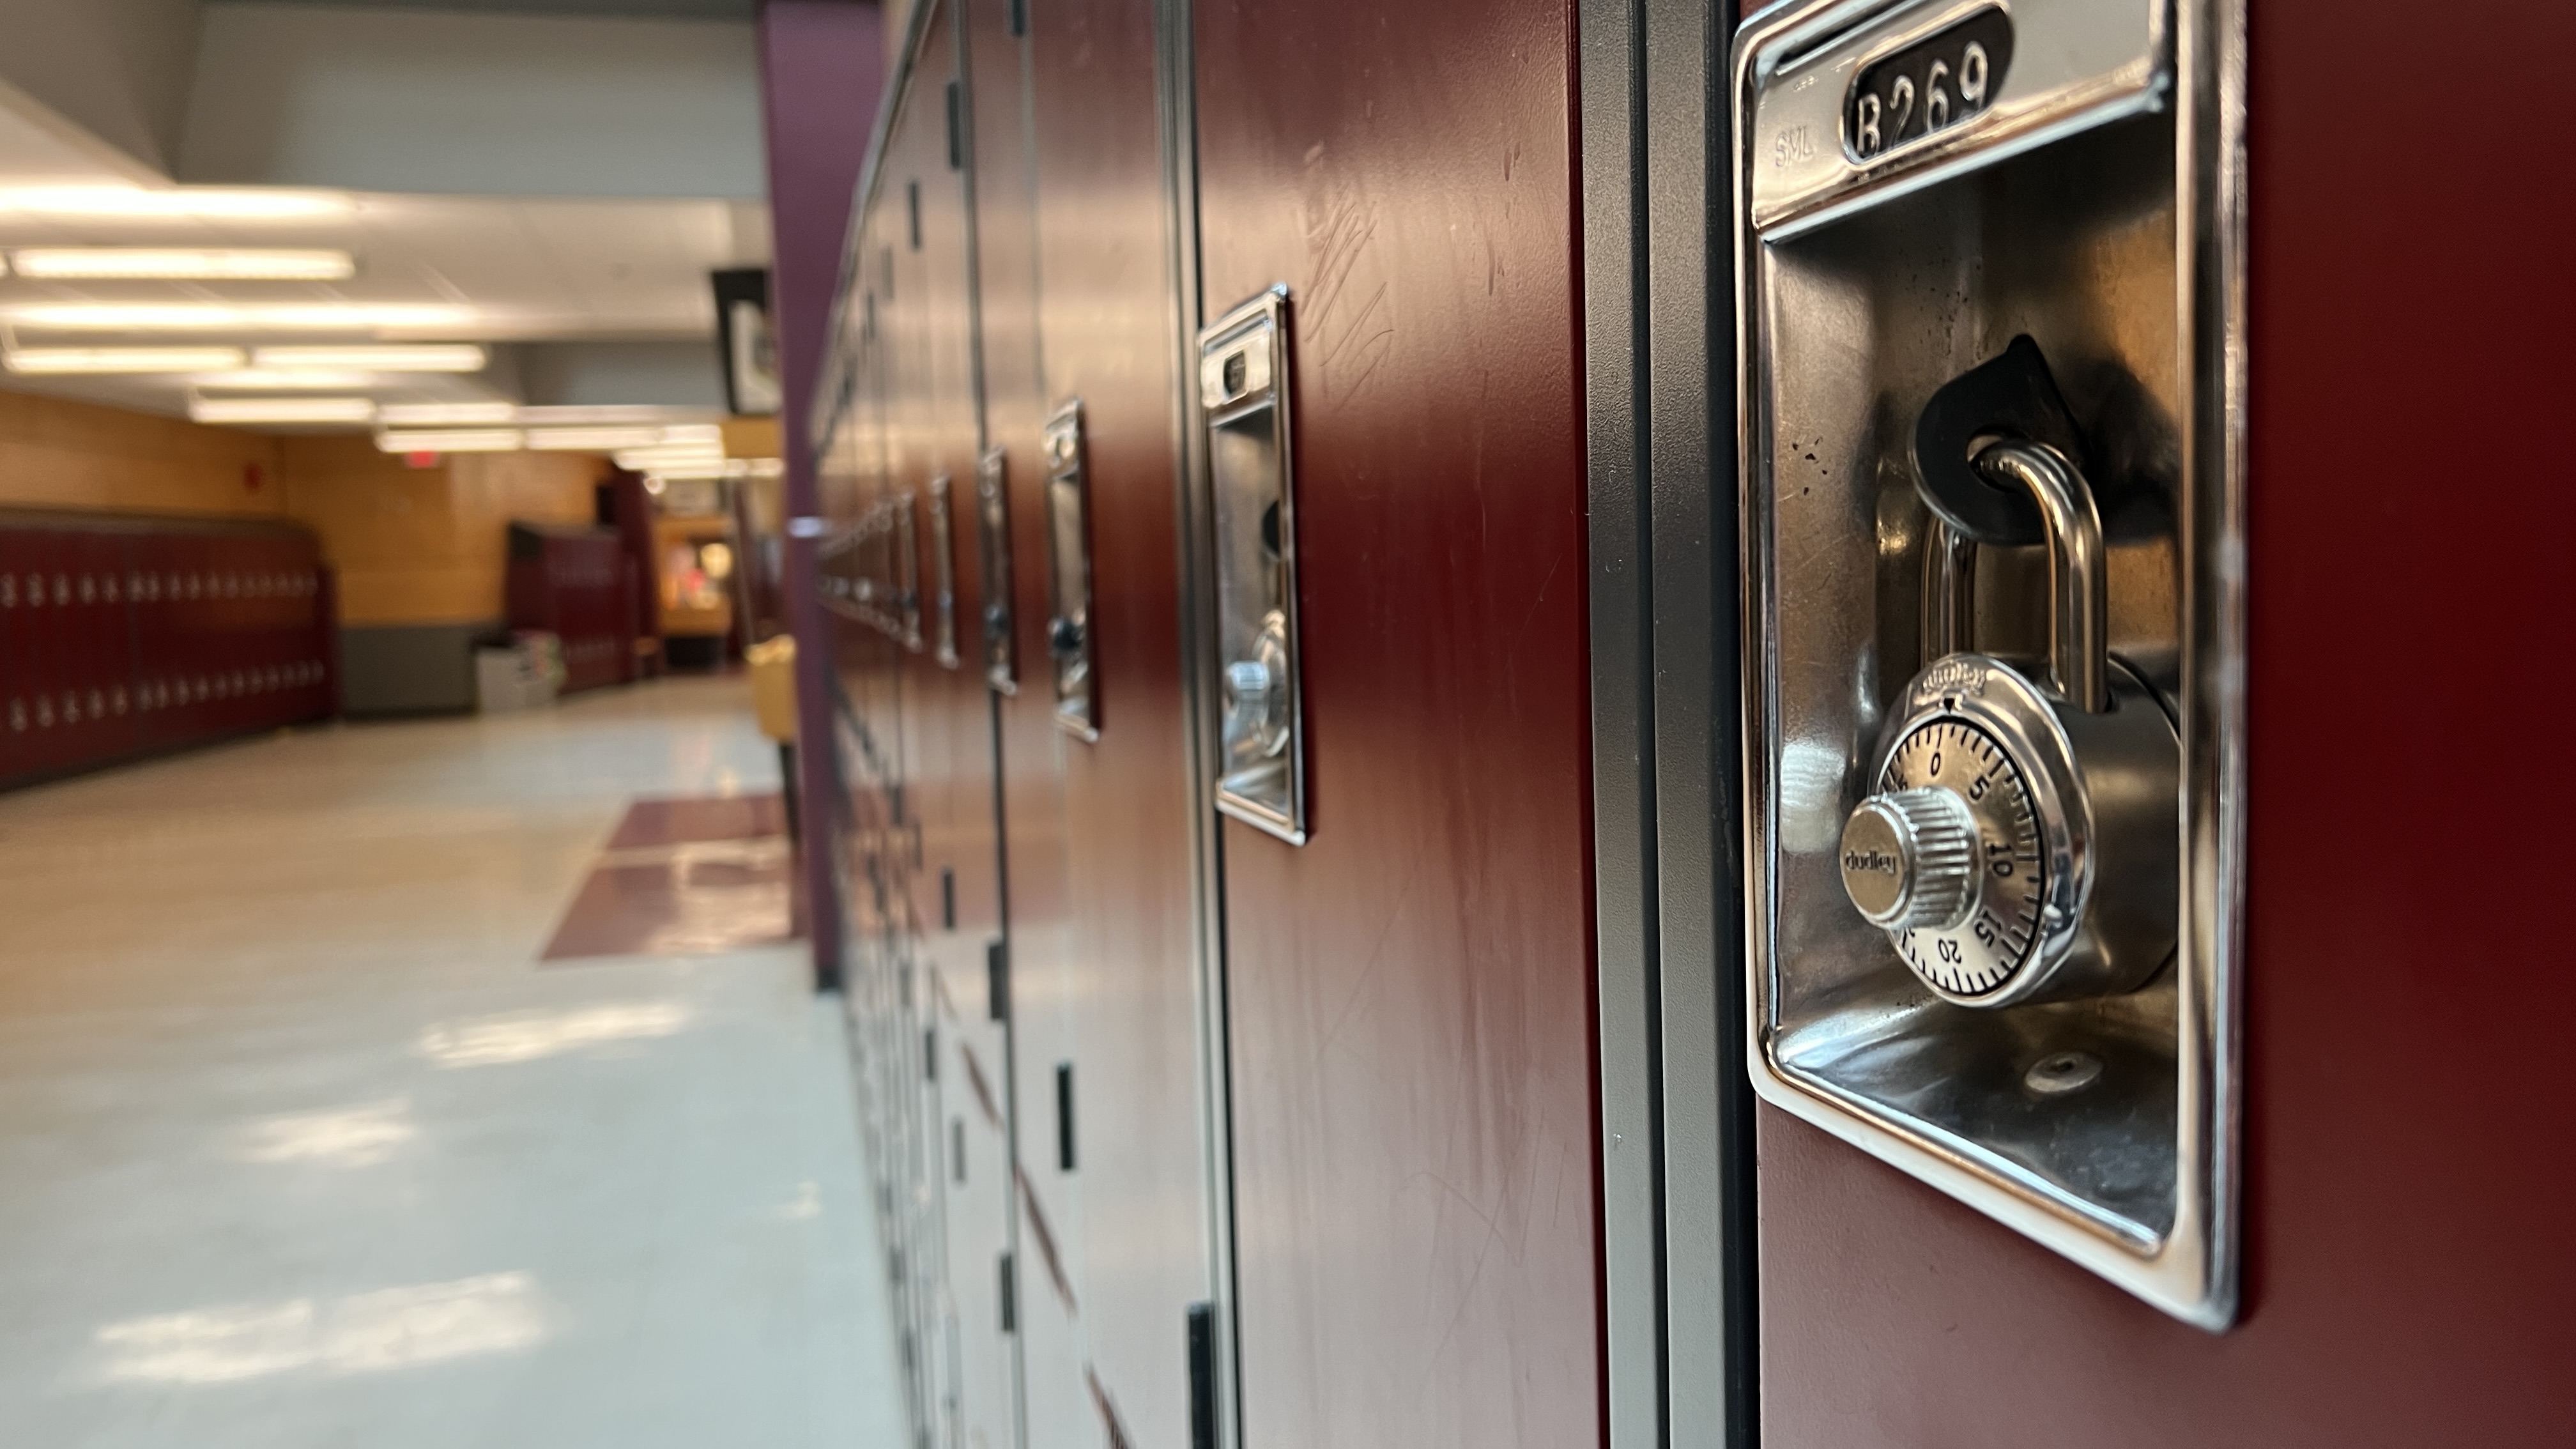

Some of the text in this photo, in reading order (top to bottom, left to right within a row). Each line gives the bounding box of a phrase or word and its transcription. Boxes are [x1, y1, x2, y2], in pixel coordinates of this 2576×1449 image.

[1856, 40, 1989, 158] B269
[1775, 125, 1813, 167] SML
[1931, 752, 1941, 777] 0
[1969, 775, 1989, 801] 5
[1845, 849, 1896, 876] dudley
[1989, 842, 2013, 877] 10
[1974, 909, 2002, 949] 15
[1938, 938, 1962, 964] 20
